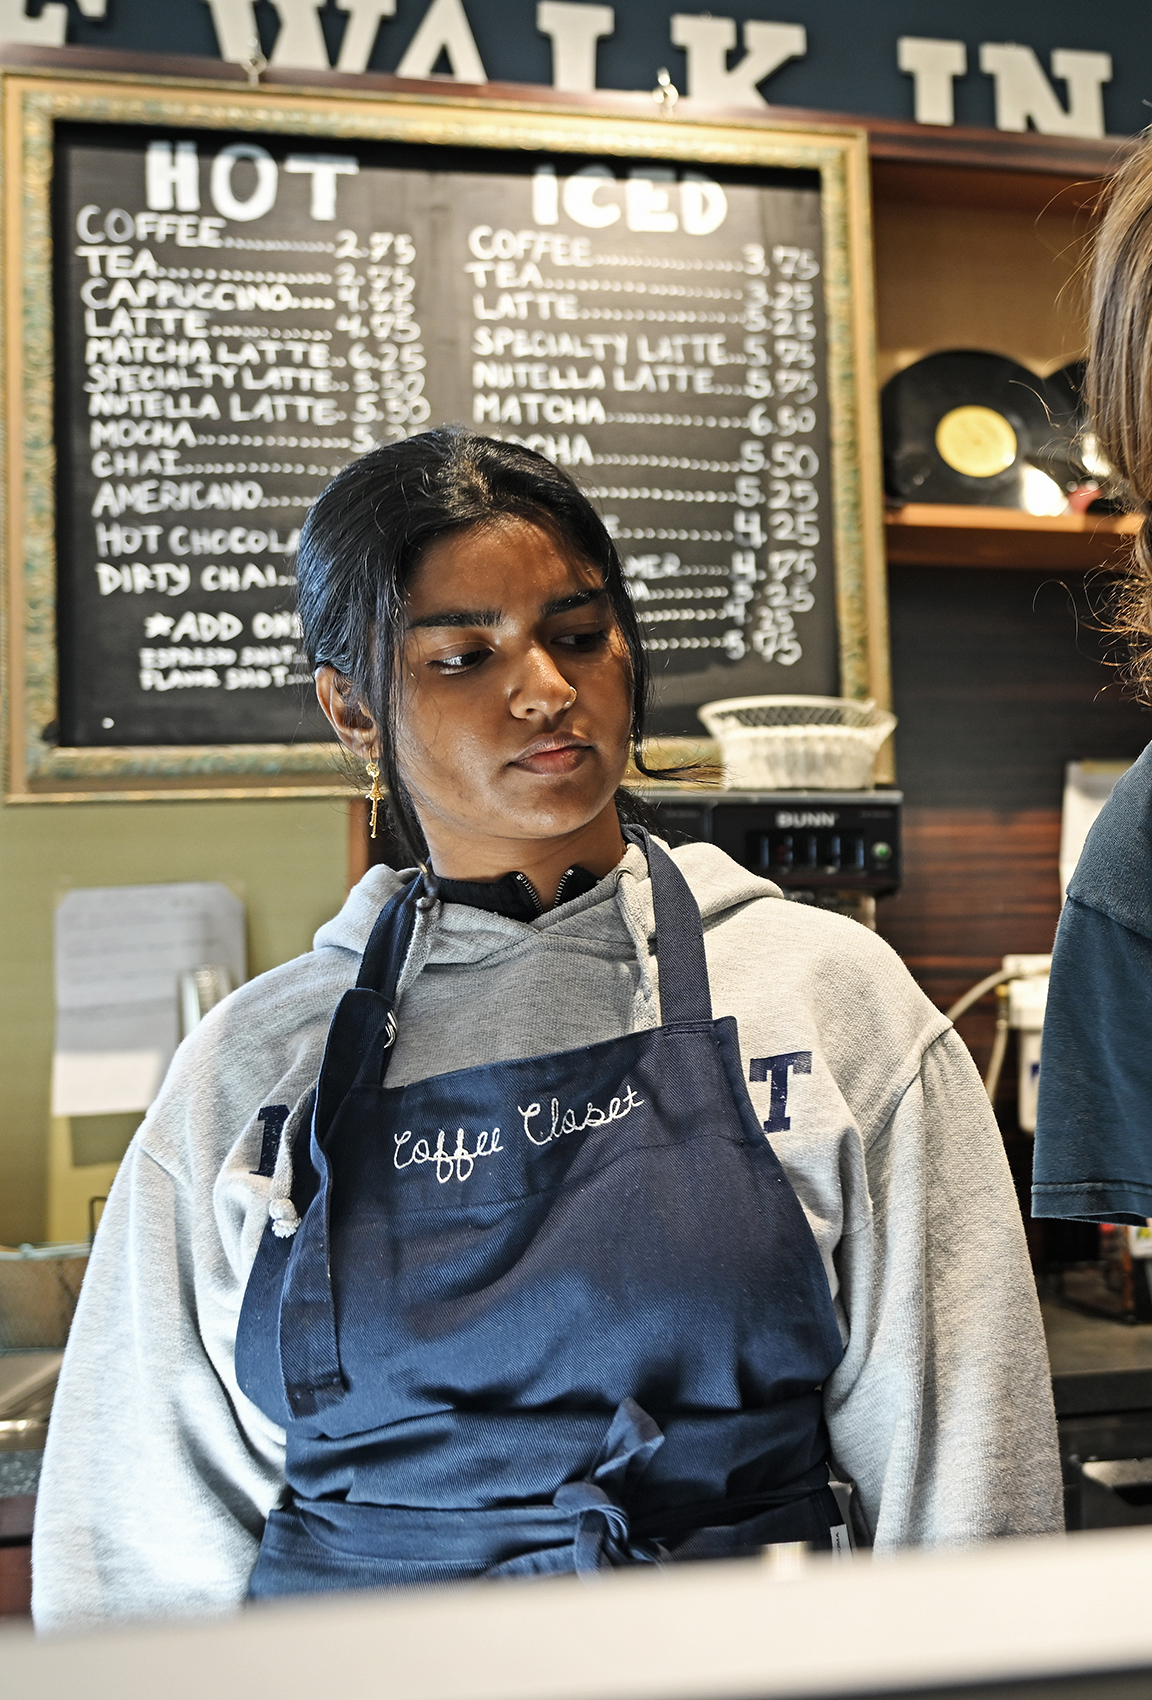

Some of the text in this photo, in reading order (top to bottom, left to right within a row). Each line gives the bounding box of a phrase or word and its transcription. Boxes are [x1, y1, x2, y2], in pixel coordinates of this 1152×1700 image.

[896, 36, 1113, 138] IN
[145, 140, 360, 222] HOT
[531, 162, 729, 236] ICED
[76, 204, 416, 265] COFFEE 2.75
[467, 224, 820, 280] COFFEE 3.75
[75, 245, 158, 278] TEA
[463, 260, 544, 289] TEA
[80, 276, 293, 311] CAPPUCCINO
[472, 290, 578, 321] LATTE
[84, 305, 210, 338] LATTE
[85, 336, 427, 372] MATCHA LATTE 6.25
[471, 324, 628, 366] SPECIALTY
[636, 332, 727, 366] LATTE
[83, 362, 238, 393] SPECIALTY
[240, 365, 333, 393] LATTE
[472, 360, 606, 391] NUTELLA
[612, 363, 714, 395] LATTE
[88, 391, 221, 420] NUTELLA
[229, 392, 338, 425] LATTE
[472, 391, 817, 438] MATCHA 6.50
[90, 419, 198, 449] MOCHA
[91, 448, 182, 478] CHAI
[738, 439, 820, 480] 5.50
[91, 479, 264, 517] AMERICANO
[95, 521, 302, 557] HOT CHOCOLA
[96, 561, 279, 597] DIRTY CHAI
[775, 811, 836, 829] BUNN
[394, 1085, 644, 1183] Coffee Closet
